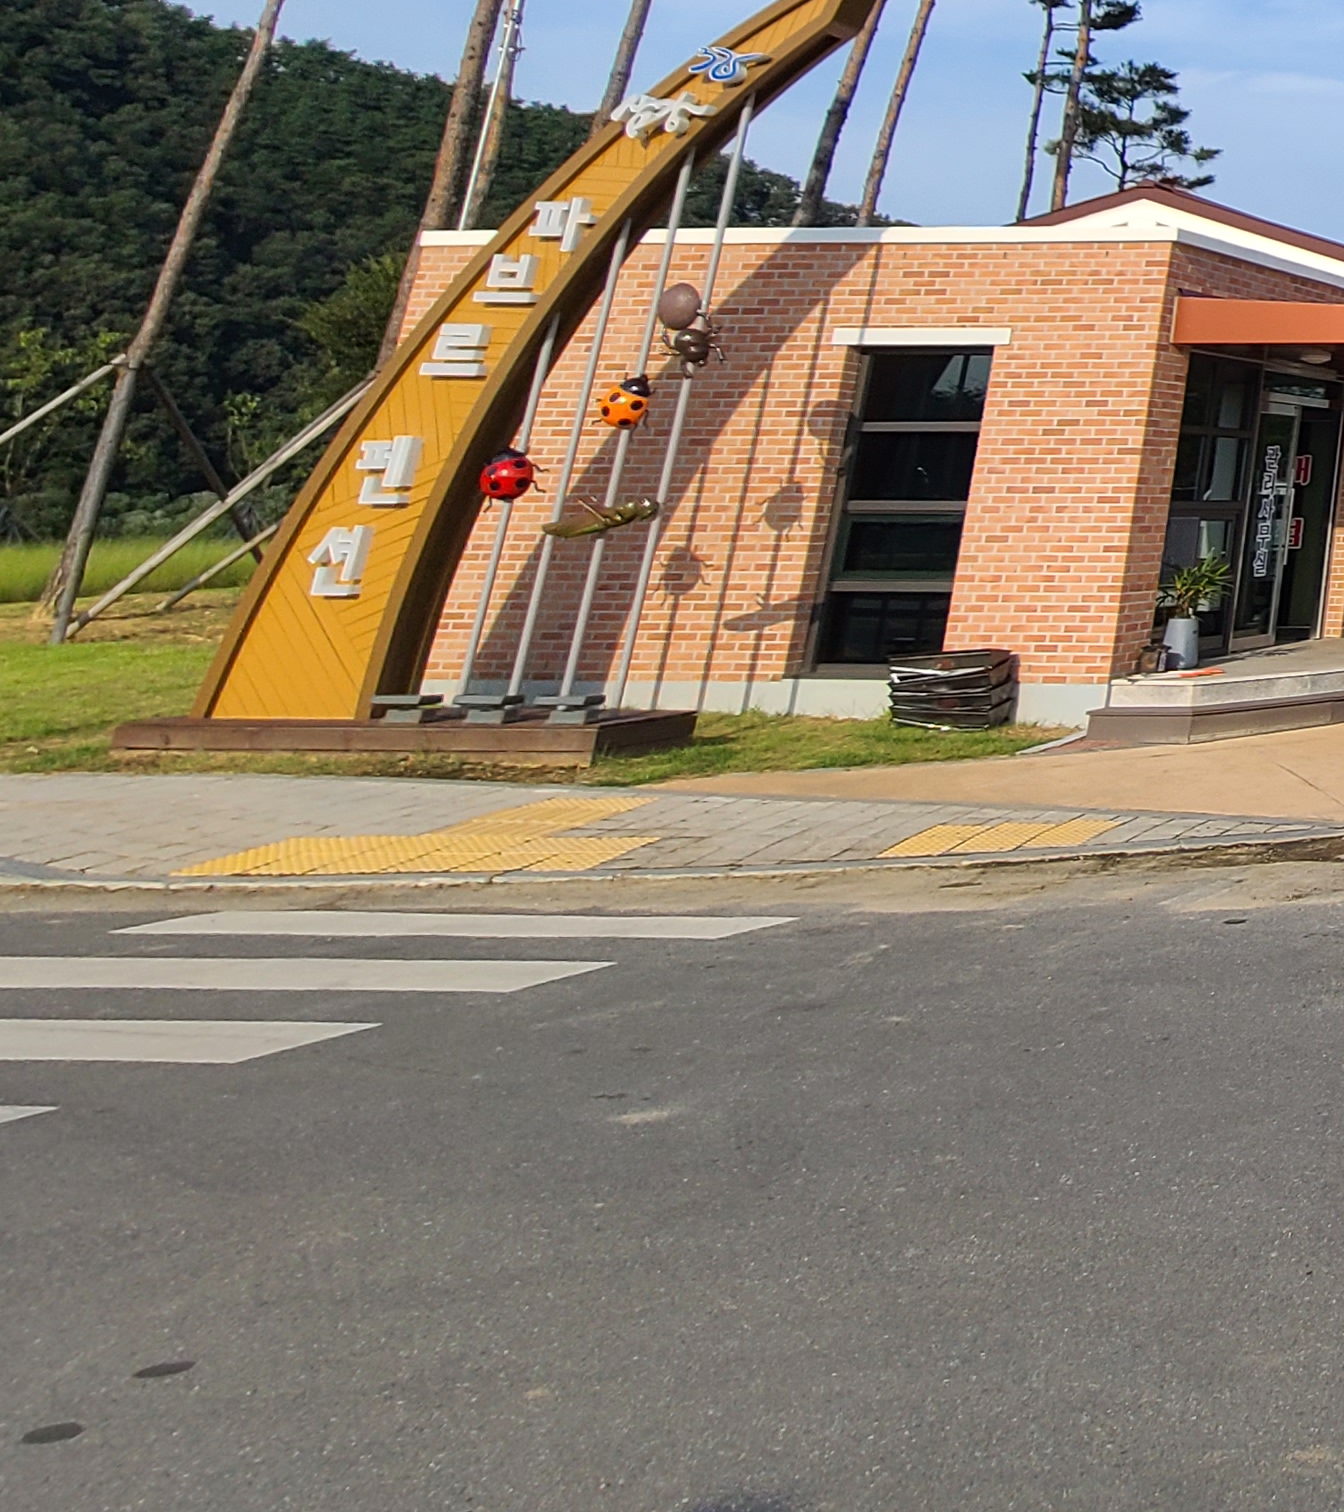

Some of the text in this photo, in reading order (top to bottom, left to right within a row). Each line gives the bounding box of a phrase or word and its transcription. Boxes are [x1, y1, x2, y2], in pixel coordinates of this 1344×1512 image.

[419, 196, 600, 378] 파브르
[307, 435, 424, 598] 펜션
[1253, 445, 1281, 577] 관리사무실
